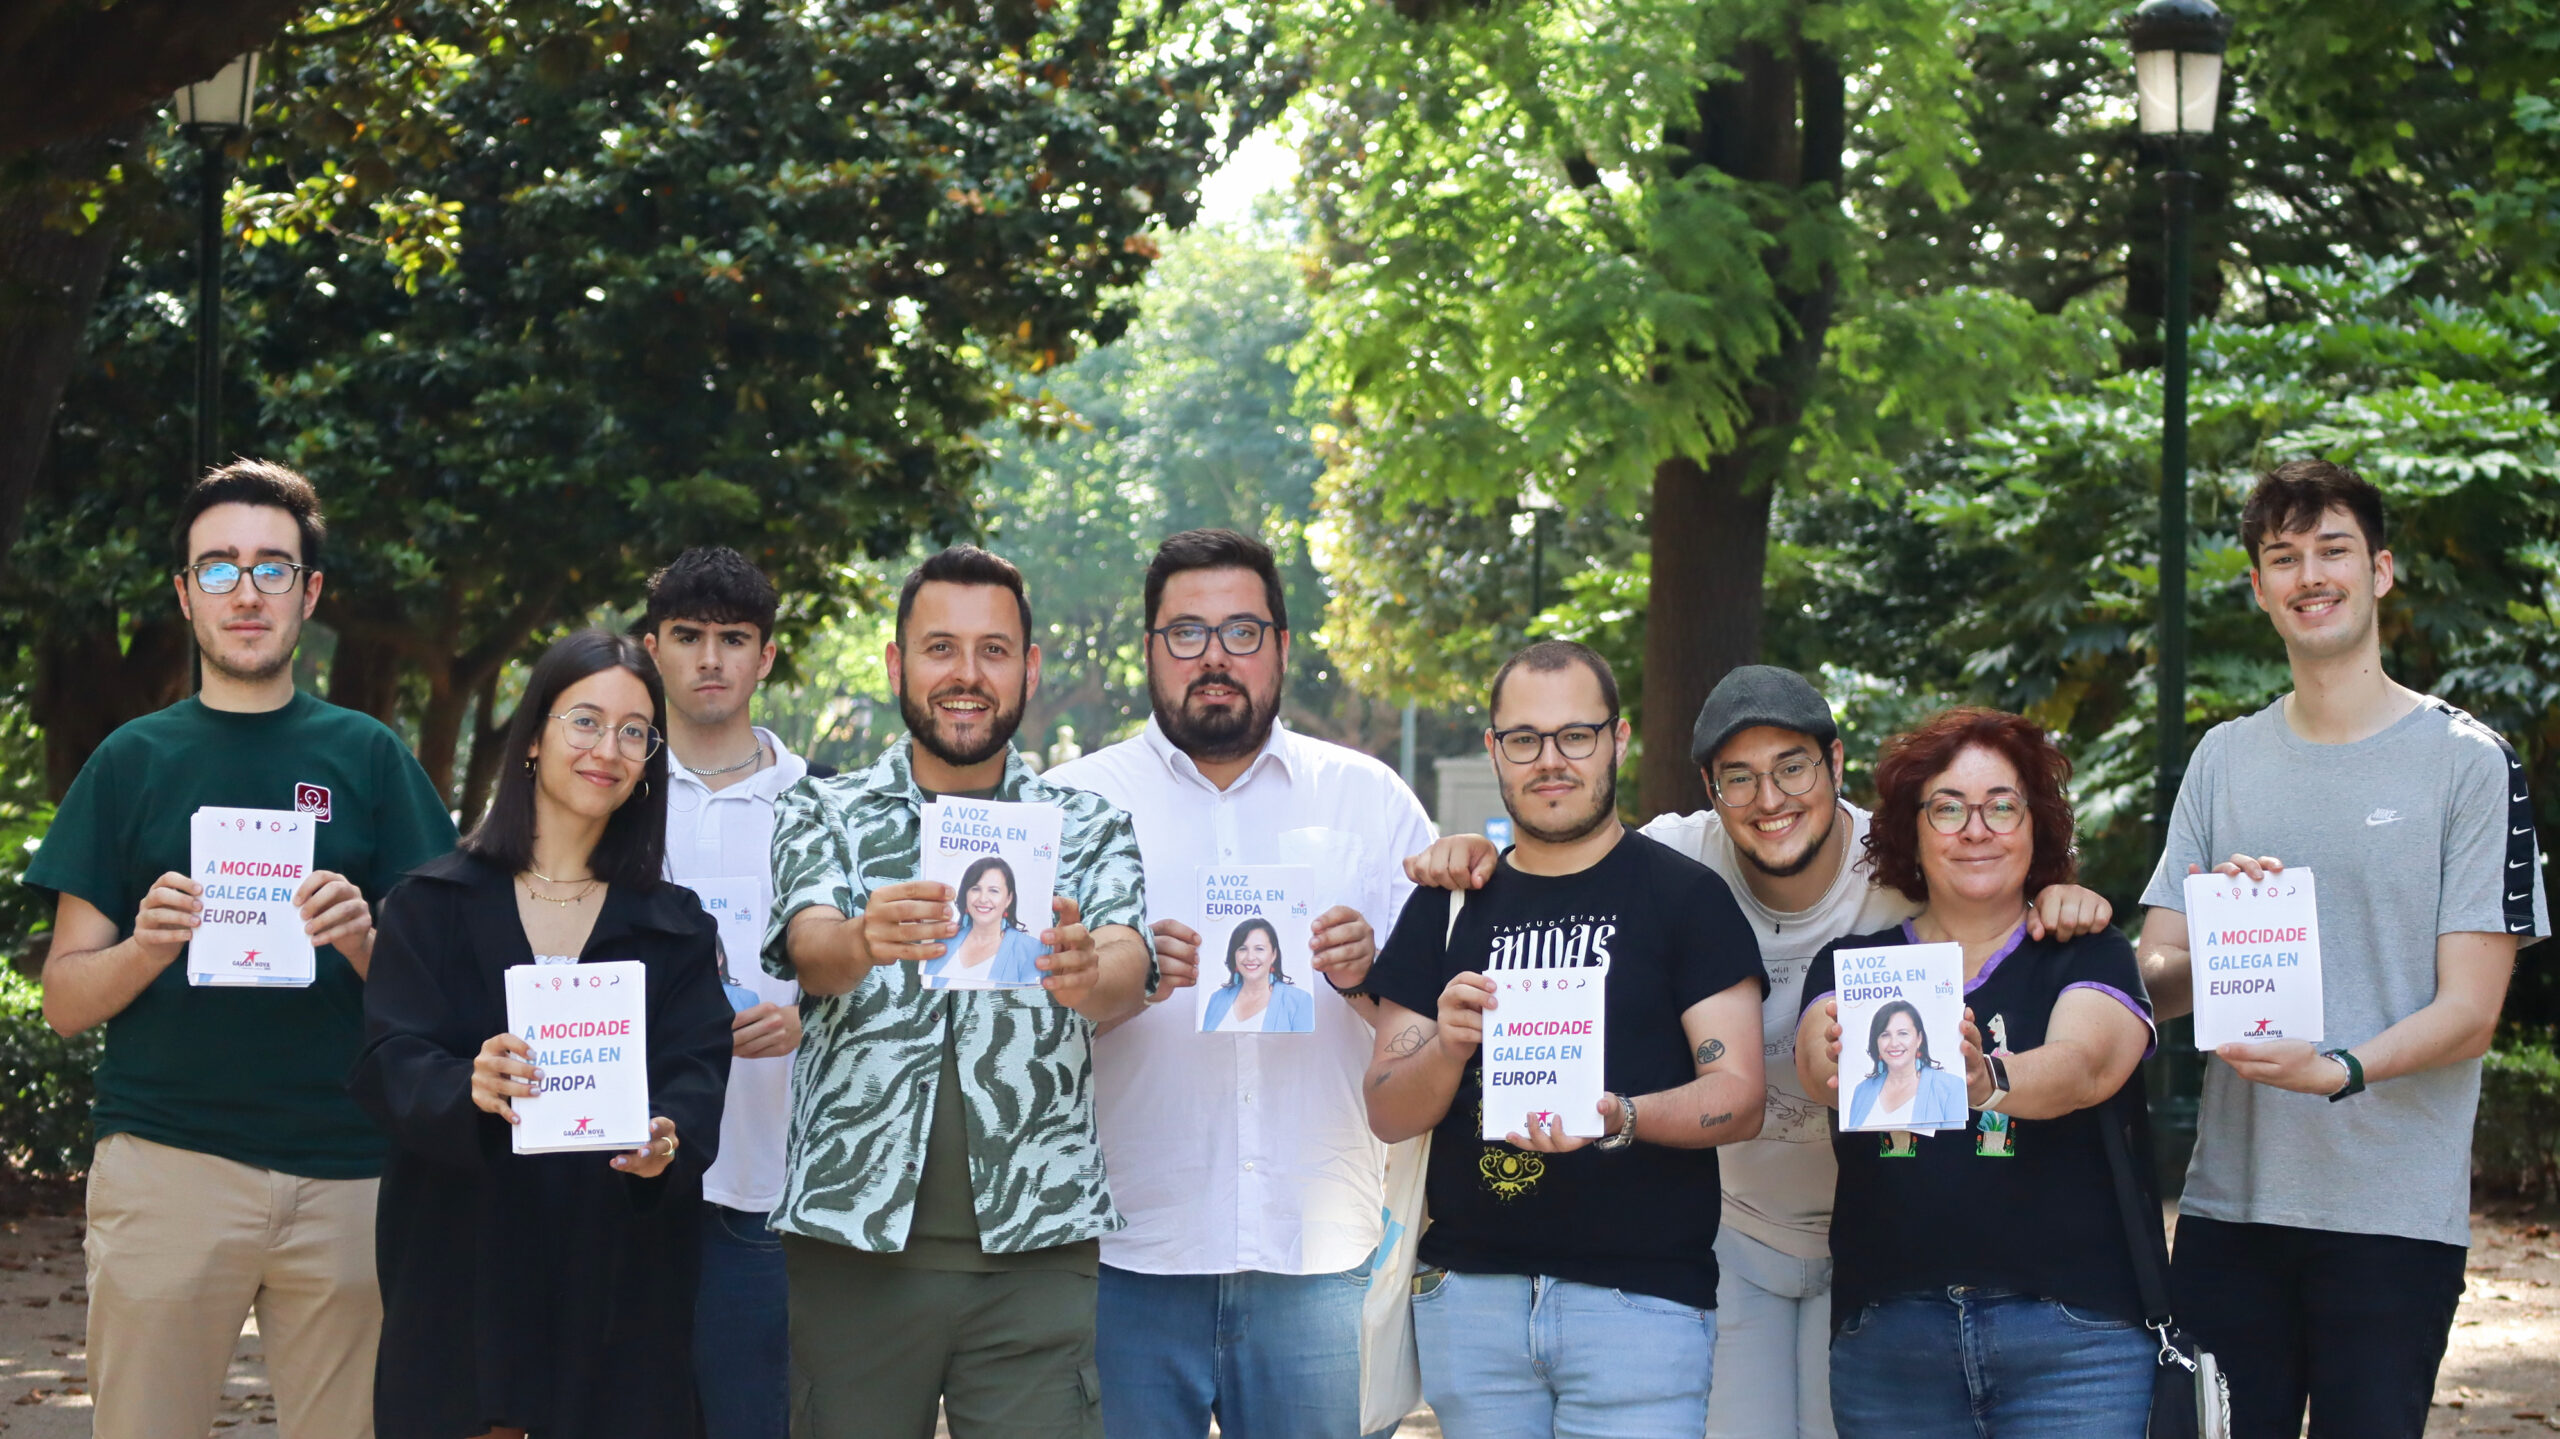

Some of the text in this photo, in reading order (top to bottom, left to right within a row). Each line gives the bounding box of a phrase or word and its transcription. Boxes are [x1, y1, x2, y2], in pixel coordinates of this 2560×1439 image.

[943, 806, 989, 821] A VOZ
[941, 821, 1027, 841] GALEGA EN
[939, 836, 1000, 854] EUROPA
[1033, 847, 1052, 859] bng
[205, 861, 303, 878] A MOCIDADE
[1206, 875, 1249, 887] A VOZ
[204, 884, 292, 902] GALEGA EN
[1206, 889, 1284, 901] GALEGA EN
[710, 898, 727, 909] EN
[1206, 903, 1262, 915] EUROPA
[1291, 905, 1307, 916] bng
[202, 908, 267, 925] EUROPA
[735, 912, 751, 922] bng
[2206, 927, 2307, 946] A MOCIDADE
[1842, 956, 1886, 971] A VOZ
[2208, 952, 2298, 970] GALEGA EN
[1770, 976, 1792, 985] KAY.
[1843, 969, 1926, 986] GALEGA EN
[1843, 986, 1903, 1002] EUROPA
[1935, 984, 1954, 996] bng
[2210, 978, 2276, 996] EUROPA
[524, 1020, 631, 1041] A MOCIDADE
[1493, 1020, 1593, 1037] A MOCIDADE
[598, 1047, 621, 1062] EN
[1493, 1045, 1582, 1062] GALEGA EN
[1492, 1071, 1558, 1086] EUROPA
